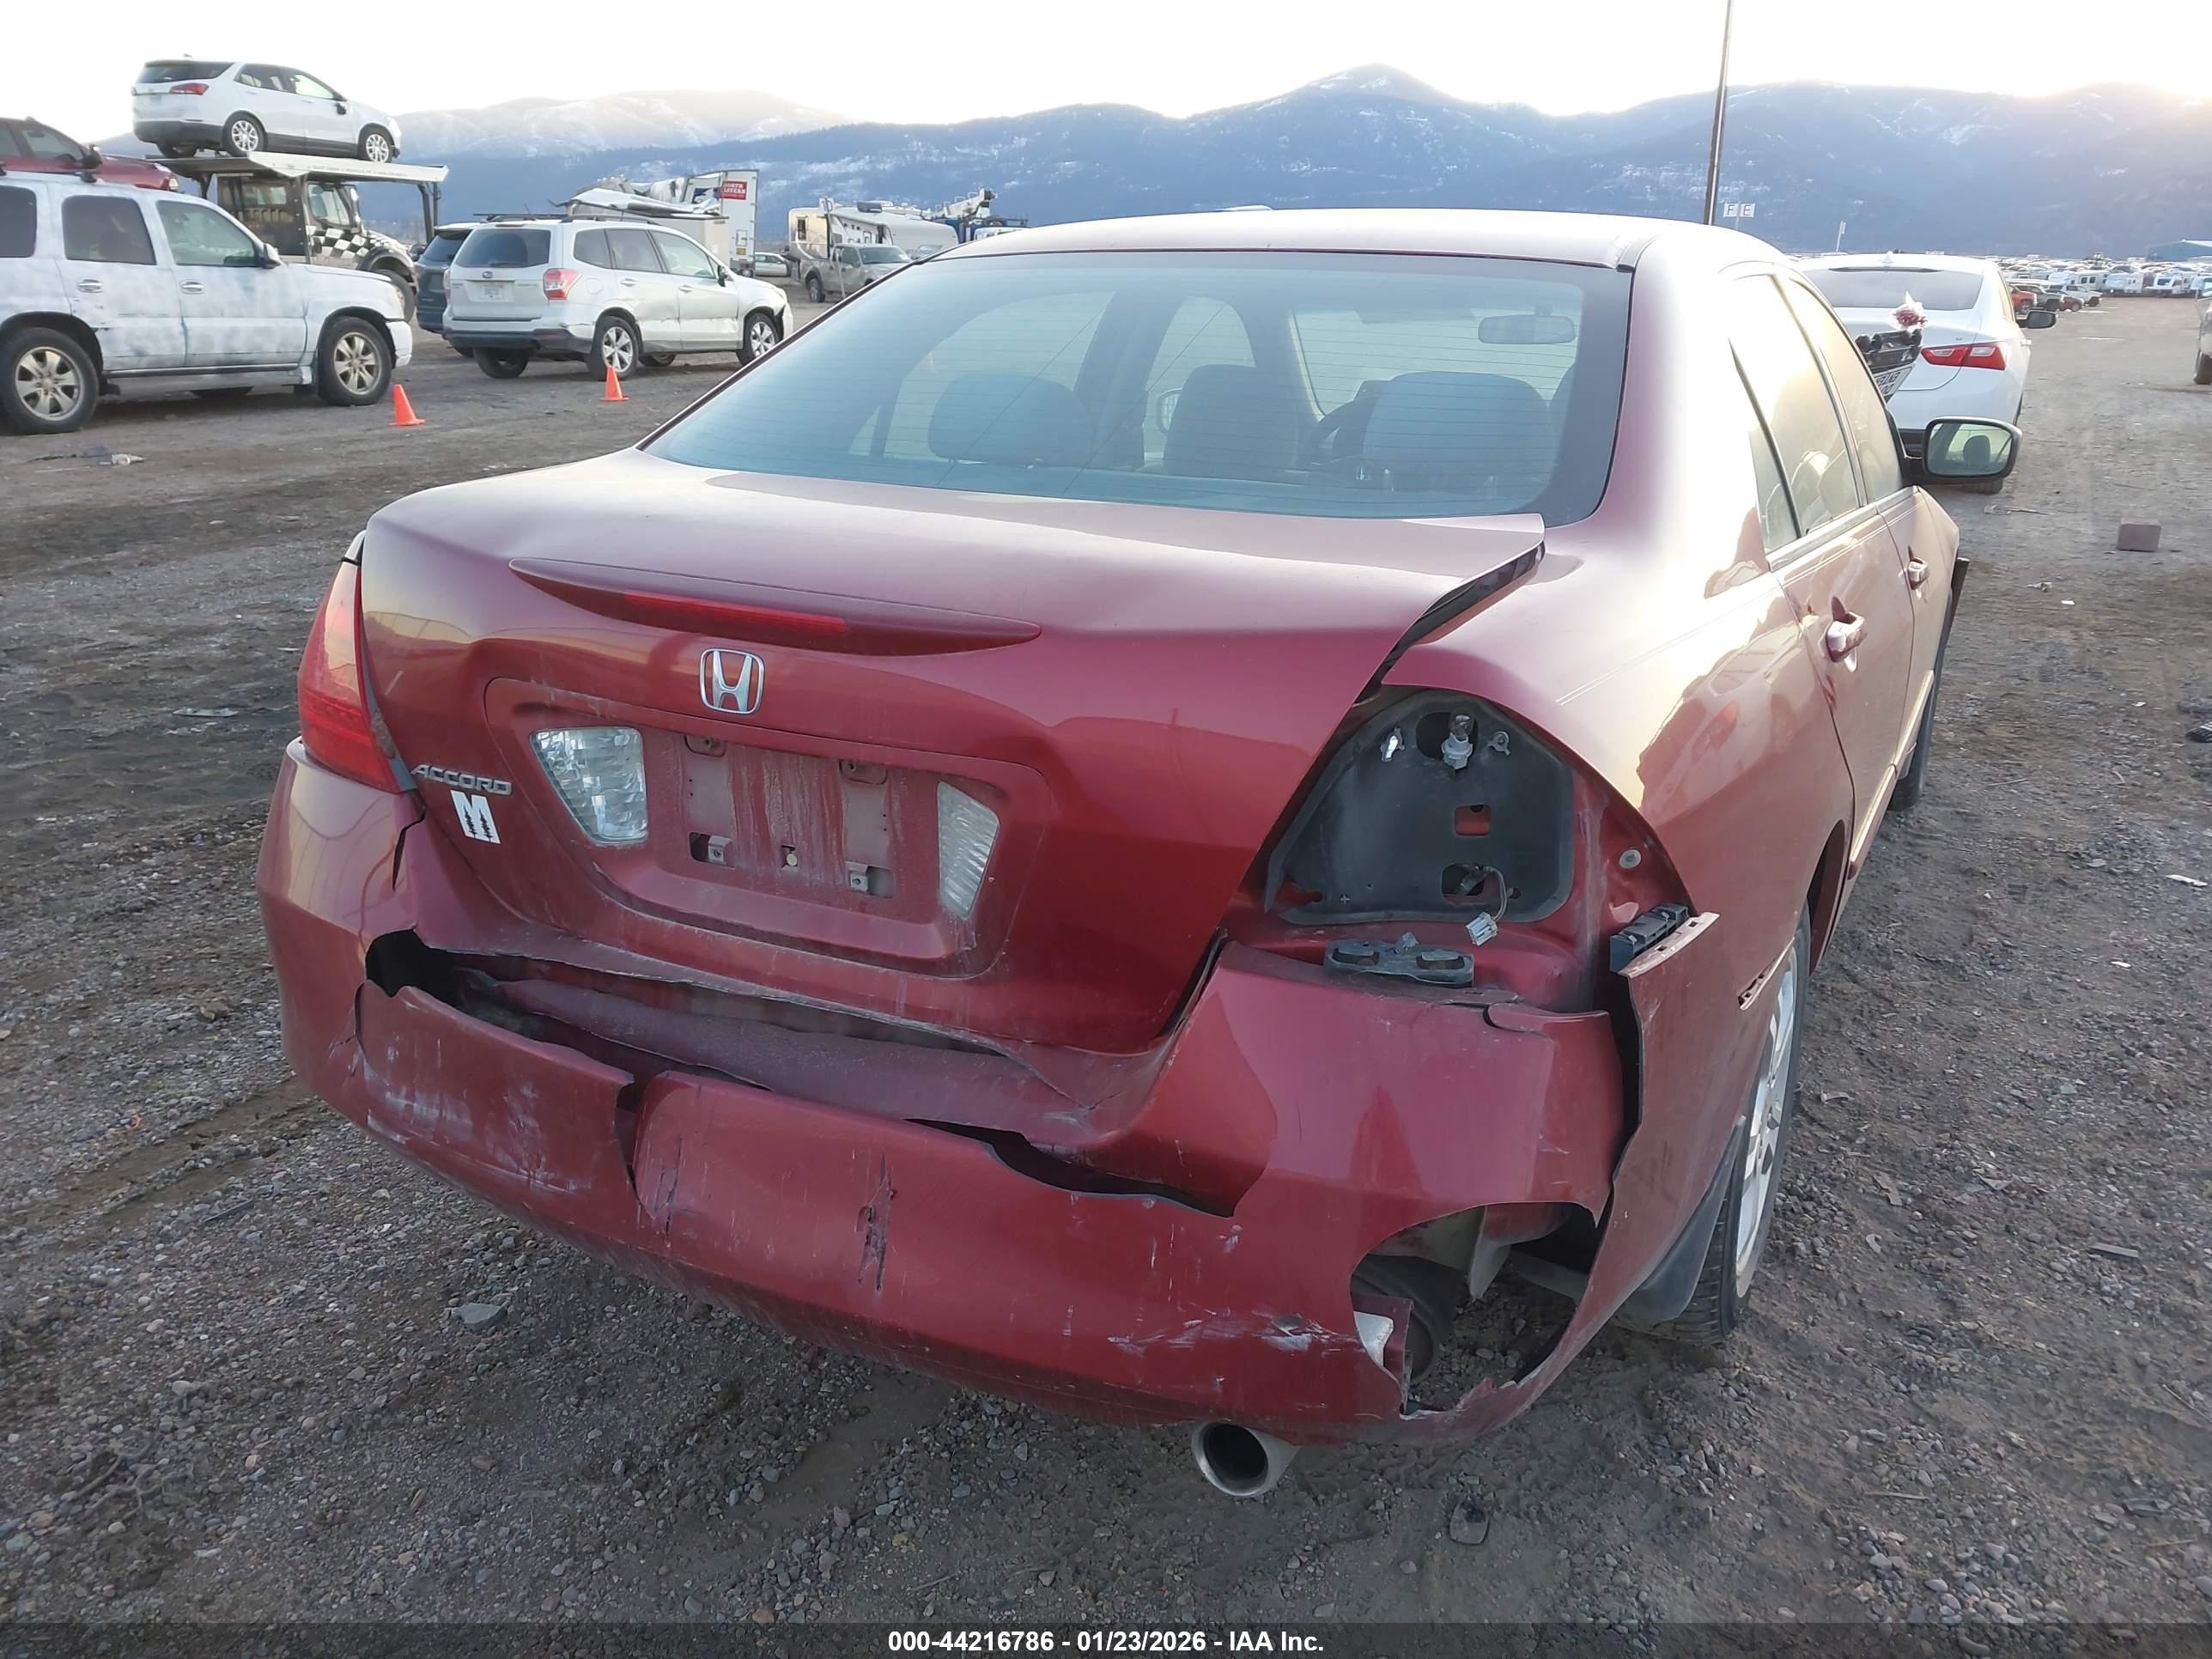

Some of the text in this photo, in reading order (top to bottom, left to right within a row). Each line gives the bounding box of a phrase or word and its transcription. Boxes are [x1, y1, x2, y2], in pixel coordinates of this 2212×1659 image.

[1727, 204, 1752, 216] F E
[410, 763, 513, 795] ACCORD
[450, 789, 501, 845] M
